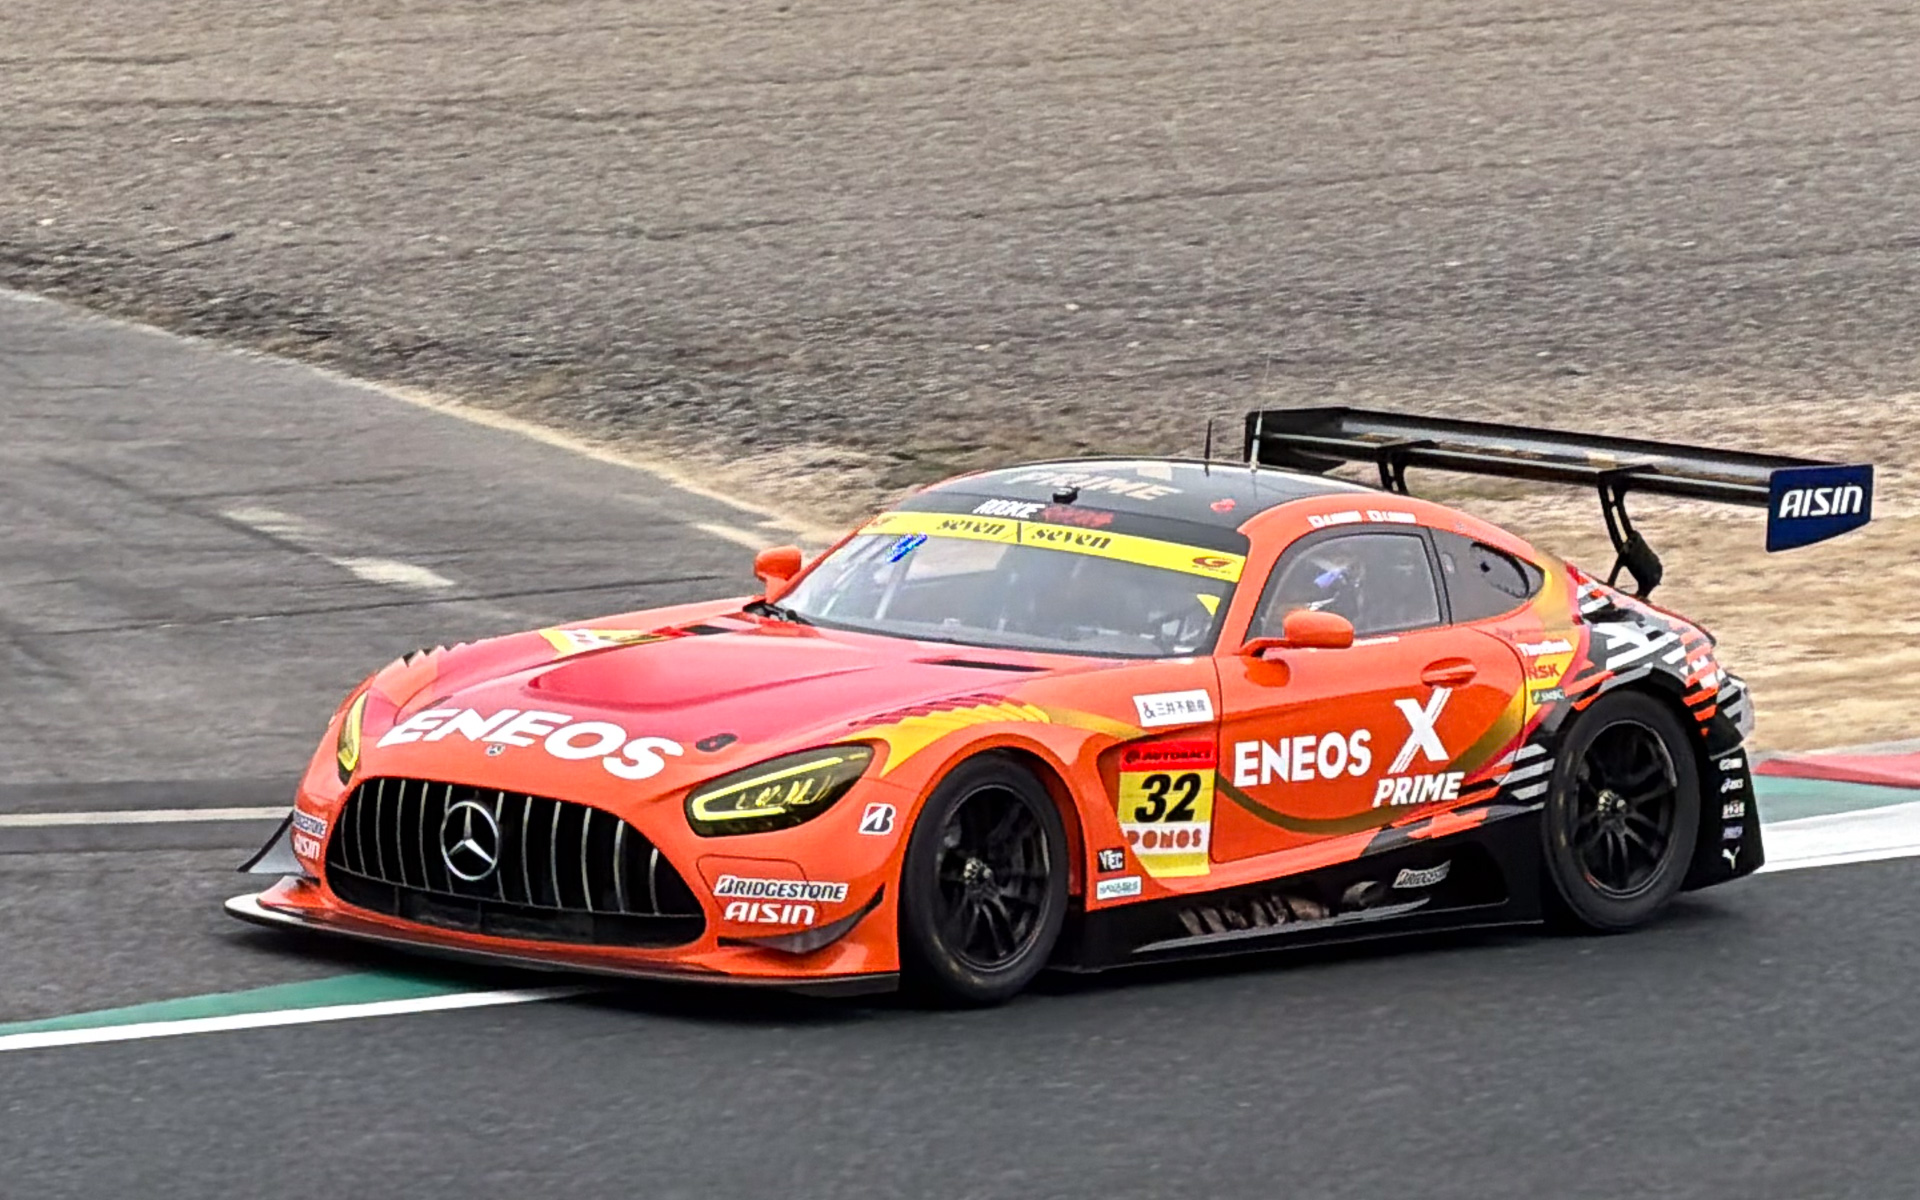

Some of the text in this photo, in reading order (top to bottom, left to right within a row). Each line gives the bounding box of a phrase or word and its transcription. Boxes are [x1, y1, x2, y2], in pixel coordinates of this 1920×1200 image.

[1779, 486, 1863, 518] AISIN
[937, 519, 1006, 535] seven
[1032, 528, 1111, 549] seven
[376, 708, 684, 780] ENEOS
[1233, 729, 1372, 787] ENEOS
[1134, 773, 1202, 823] 32
[1372, 771, 1465, 808] PRIME
[1127, 828, 1202, 849] PONOS
[716, 877, 846, 902] BRIDGESTONE
[724, 901, 815, 925] AISIN
